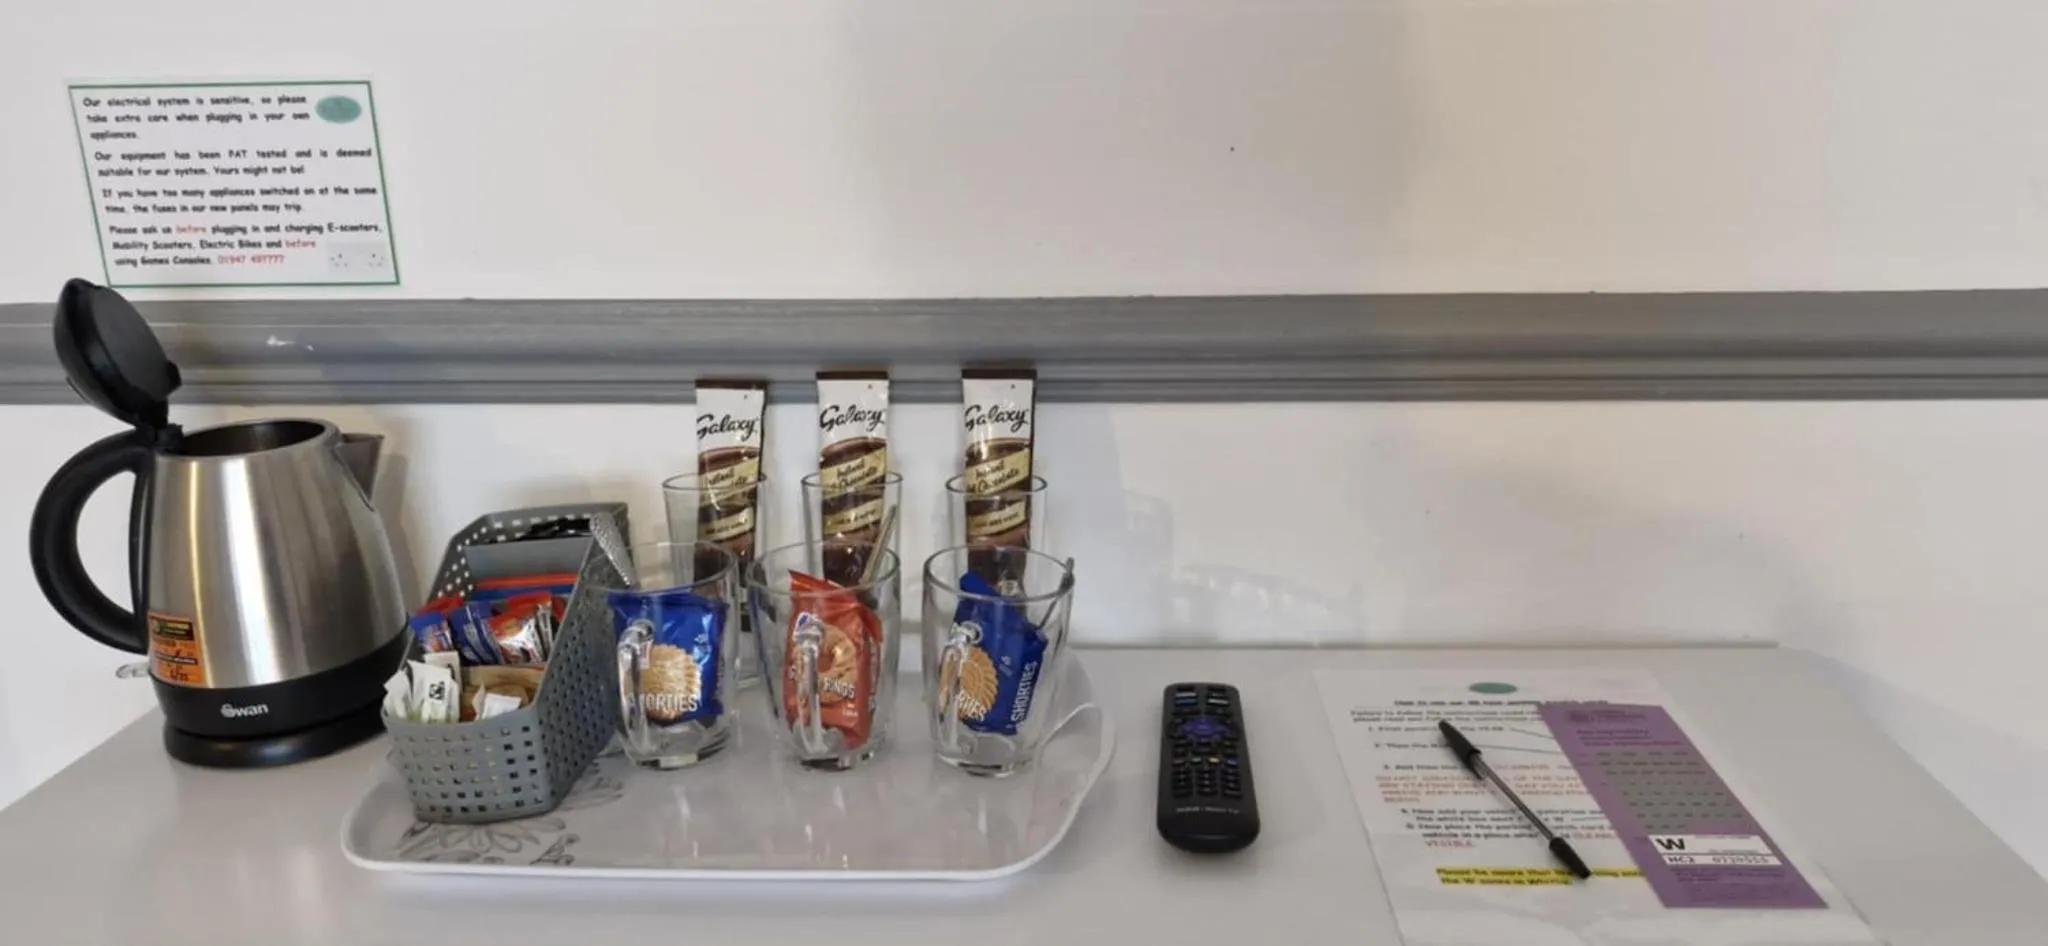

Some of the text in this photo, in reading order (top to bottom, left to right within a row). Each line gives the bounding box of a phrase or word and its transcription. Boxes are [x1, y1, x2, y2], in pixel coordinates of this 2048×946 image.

[84, 97, 100, 107] Our
[108, 97, 150, 106] electrical
[158, 98, 189, 108] system
[278, 95, 306, 105] please
[87, 115, 107, 123] take
[115, 114, 140, 122] extra
[176, 113, 198, 122] when
[206, 112, 242, 124] plugging
[265, 113, 284, 122] your
[95, 151, 112, 161] Our
[121, 152, 166, 162] equipment
[175, 151, 190, 160] has
[198, 151, 221, 159] been
[229, 149, 247, 158] PAT
[256, 149, 287, 158] tested
[295, 149, 312, 158] and
[336, 148, 372, 157] deemed
[98, 168, 133, 177] suitable
[138, 167, 151, 176] for
[214, 167, 239, 175] Yours
[243, 166, 268, 177] might
[272, 166, 286, 174] not
[103, 188, 111, 198] If
[118, 191, 132, 199] you
[137, 189, 157, 197] have
[163, 189, 177, 197] too
[182, 189, 204, 199] many
[210, 187, 255, 198] appliances
[260, 187, 299, 196] switched
[334, 186, 349, 195] the
[355, 187, 376, 195] same
[134, 204, 147, 213] the
[153, 204, 176, 213] fuses
[232, 203, 258, 213] panels
[263, 204, 279, 213] may
[109, 225, 138, 234] Please
[142, 226, 158, 234] ask
[176, 225, 206, 233] before
[211, 225, 248, 236] plugging
[264, 224, 281, 233] and
[284, 224, 324, 235] charging
[112, 241, 148, 251] Mobility
[199, 240, 234, 249] Electric
[238, 239, 262, 249] Bikes
[266, 240, 282, 248] and
[286, 239, 315, 247] before
[116, 258, 137, 268] using
[141, 256, 168, 265] Games
[820, 404, 888, 431] Galaxy
[965, 404, 1030, 432] Galaxy
[697, 413, 760, 440] Galaxy
[1010, 660, 1038, 723] SHORTIES
[220, 702, 270, 719] Swan
